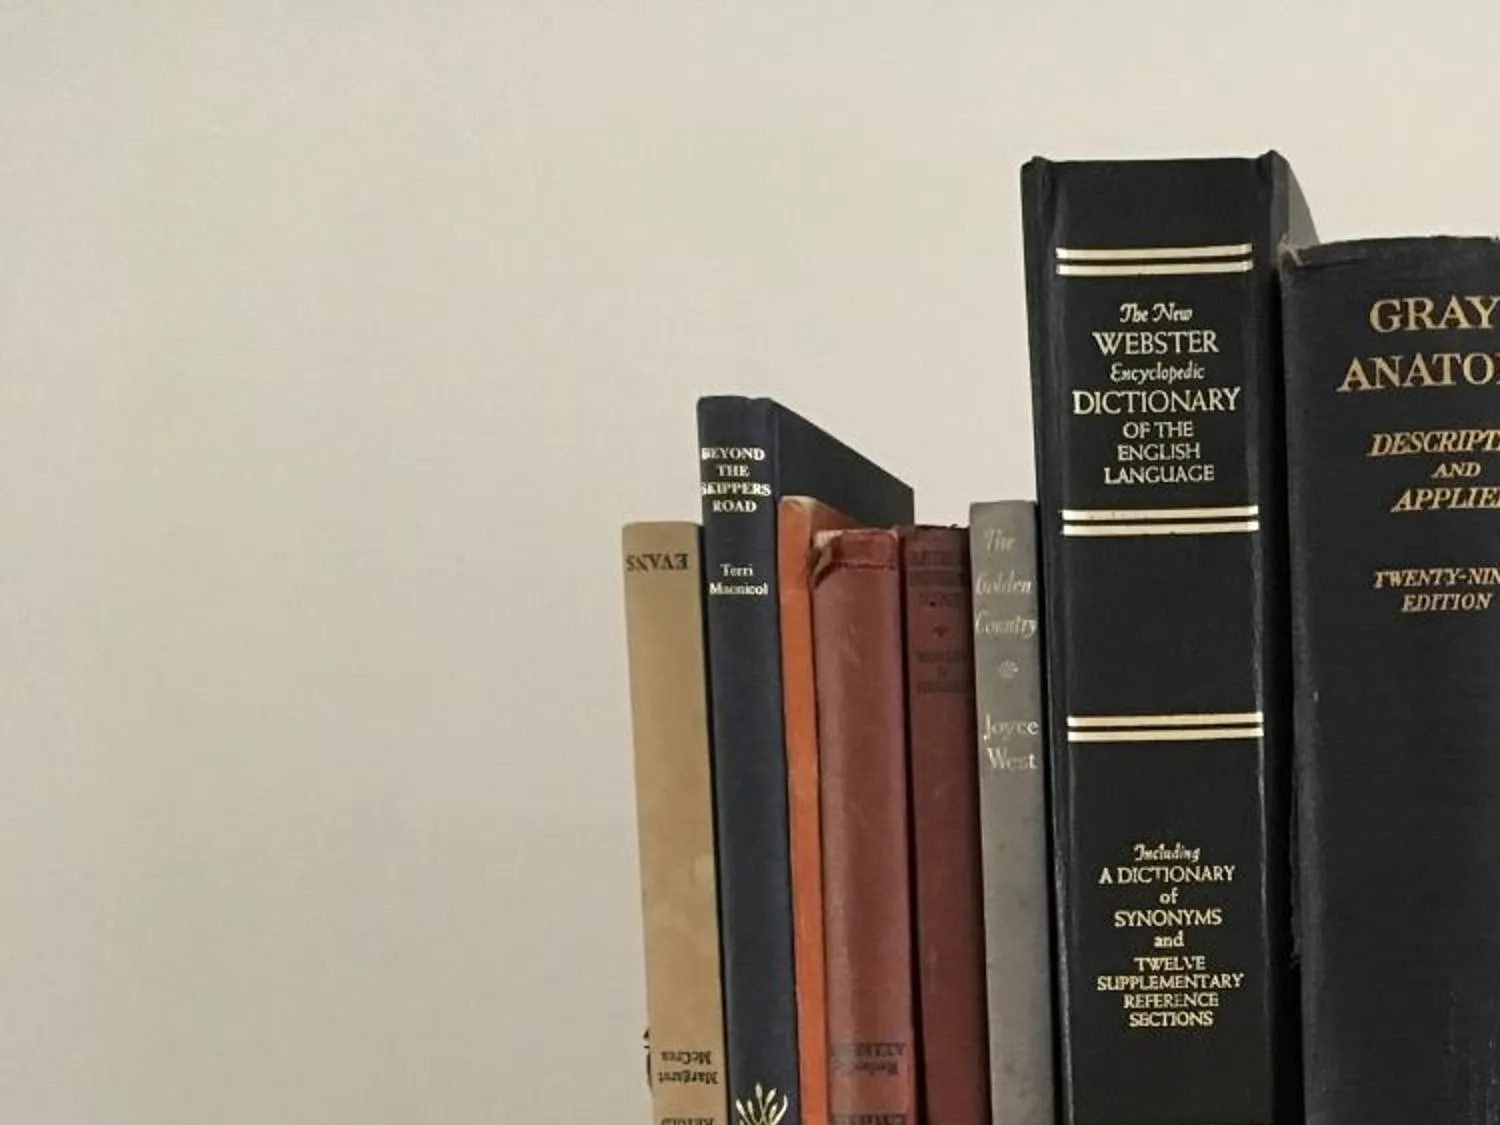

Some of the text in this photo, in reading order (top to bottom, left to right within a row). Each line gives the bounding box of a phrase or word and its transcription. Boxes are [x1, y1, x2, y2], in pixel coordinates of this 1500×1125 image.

[1119, 301, 1194, 323] The New
[1091, 329, 1220, 356] WEBSTER
[1110, 360, 1206, 385] Encyclopedic
[1072, 386, 1241, 415] DICTIONARY
[1122, 420, 1194, 439] OF THE
[701, 447, 766, 462] BEYOND
[1116, 442, 1201, 462] ENGLISH
[717, 463, 750, 478] THE
[1103, 464, 1215, 485] LANGUAGE
[1431, 461, 1481, 479] AND
[712, 499, 758, 514] ROAD
[626, 552, 689, 571] EVANS
[720, 563, 754, 578] Terri
[1401, 592, 1493, 613] EDITION
[983, 712, 1040, 741] Joyce
[987, 747, 1038, 770] West
[1133, 842, 1201, 862] Including
[1098, 865, 1236, 885] A DICTIONARY
[1159, 887, 1179, 904] of
[1114, 908, 1223, 928] SYNONYMS
[1154, 929, 1185, 948] and
[1133, 955, 1207, 972] TWELVE
[1096, 972, 1245, 991] SUPPLEMENTARY
[1123, 991, 1220, 1009] REFERENCE
[1128, 1010, 1215, 1028] SECTIONS
